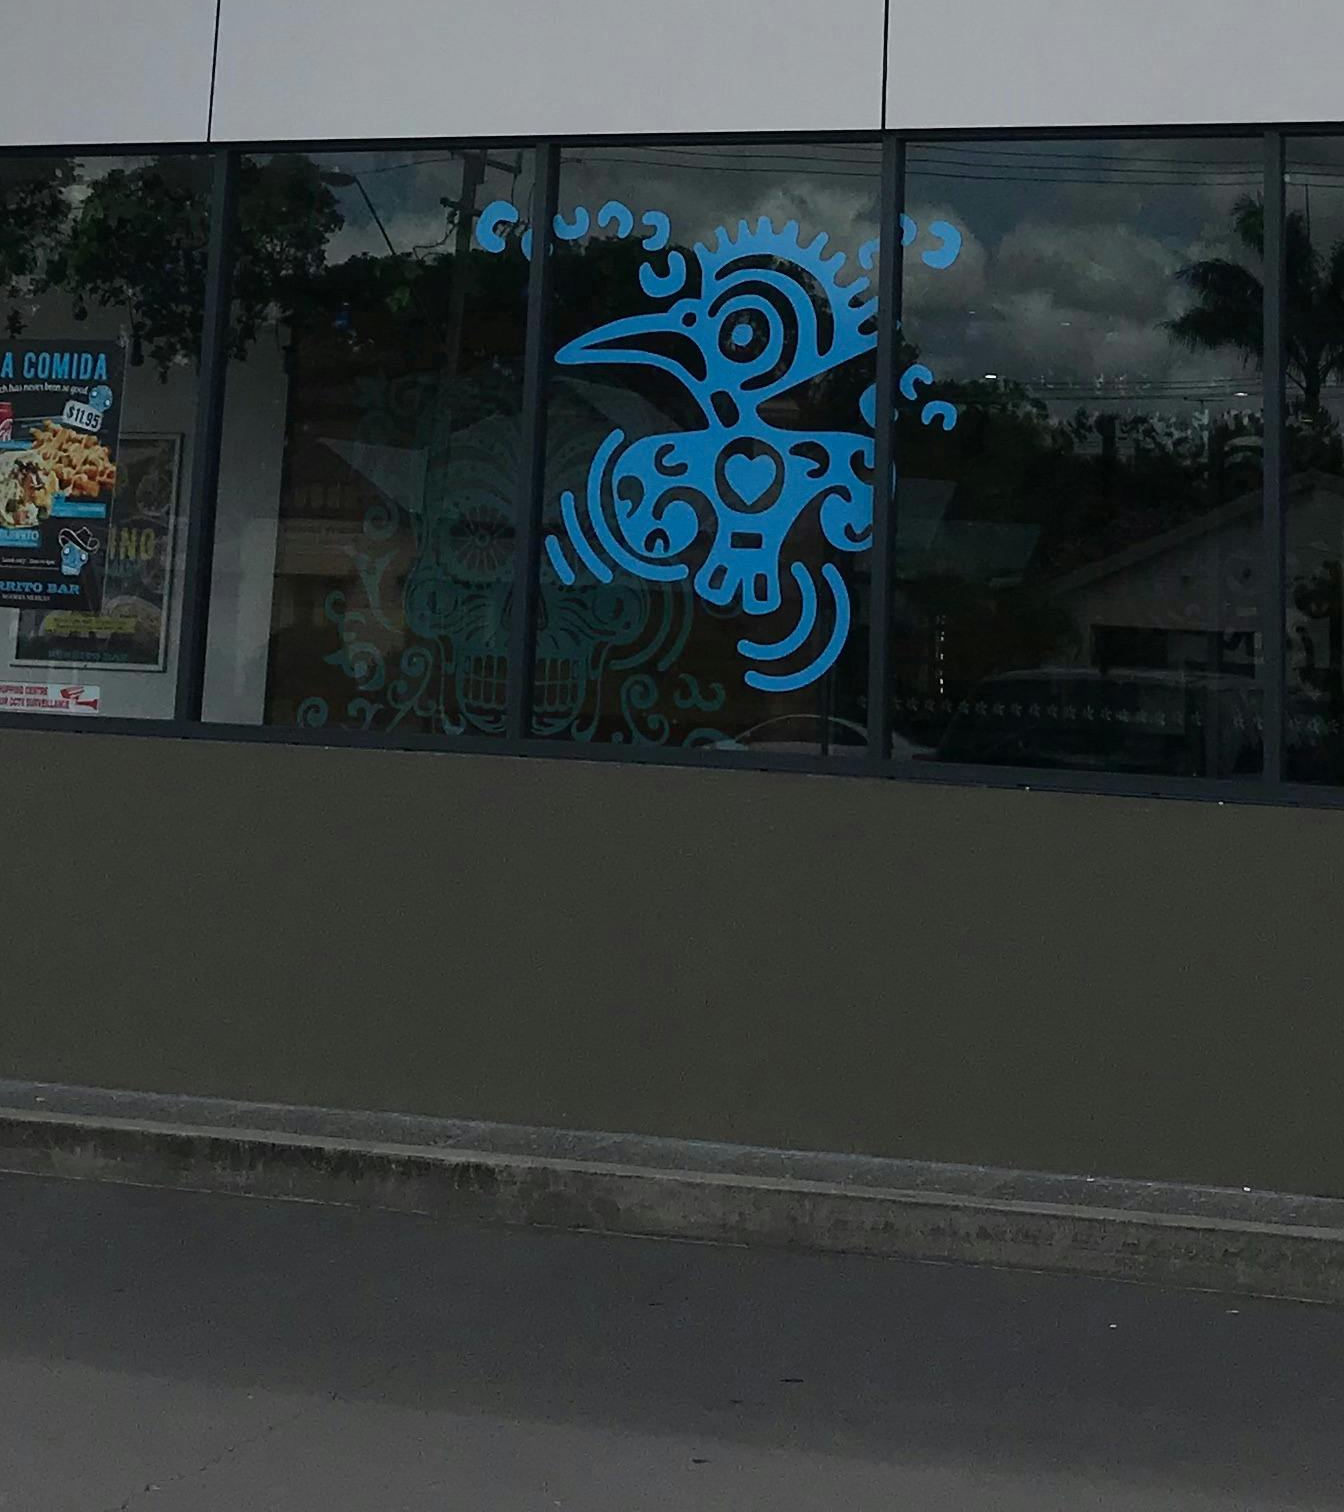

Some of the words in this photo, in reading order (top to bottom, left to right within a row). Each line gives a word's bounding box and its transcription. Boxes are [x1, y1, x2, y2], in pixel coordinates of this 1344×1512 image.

[22, 351, 108, 380] COMIDA
[67, 406, 101, 430] $11.95
[47, 582, 81, 595] BAR
